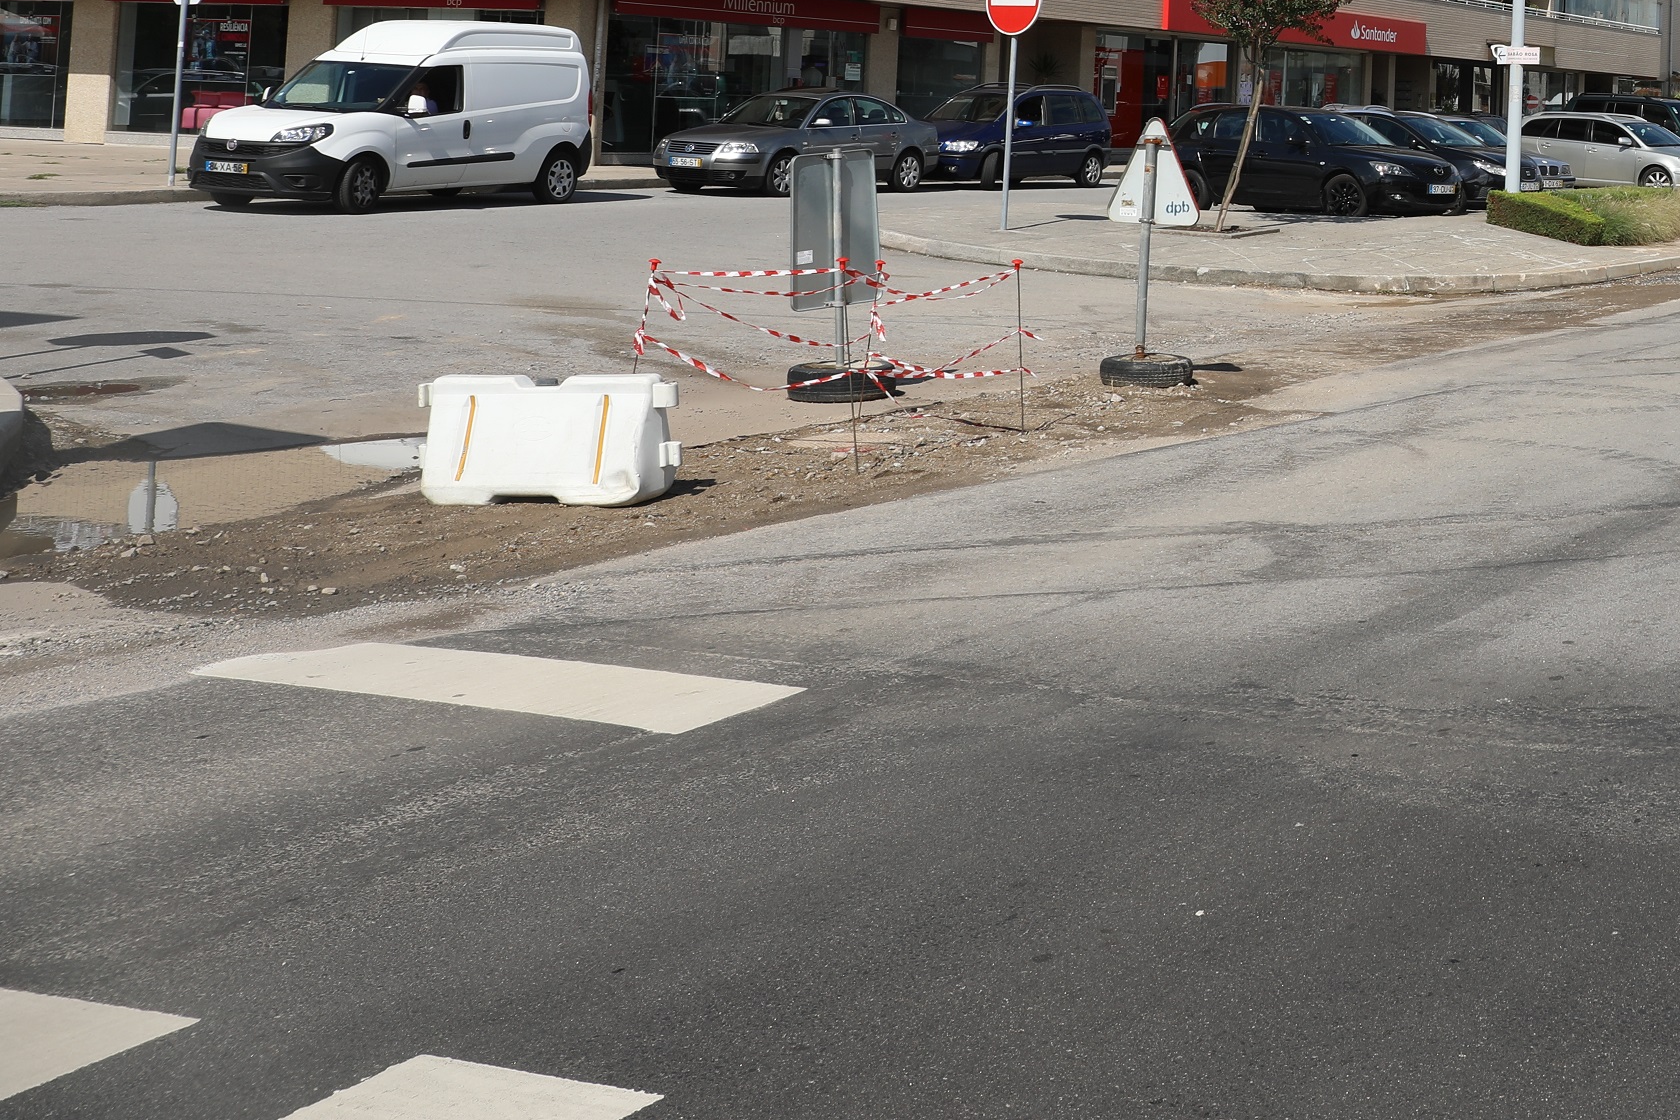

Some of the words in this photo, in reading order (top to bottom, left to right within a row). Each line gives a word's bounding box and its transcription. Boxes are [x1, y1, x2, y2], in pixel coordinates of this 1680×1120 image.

[772, 15, 785, 25] bcp
[1360, 25, 1397, 43] Santander
[1165, 201, 1190, 216] dpb
